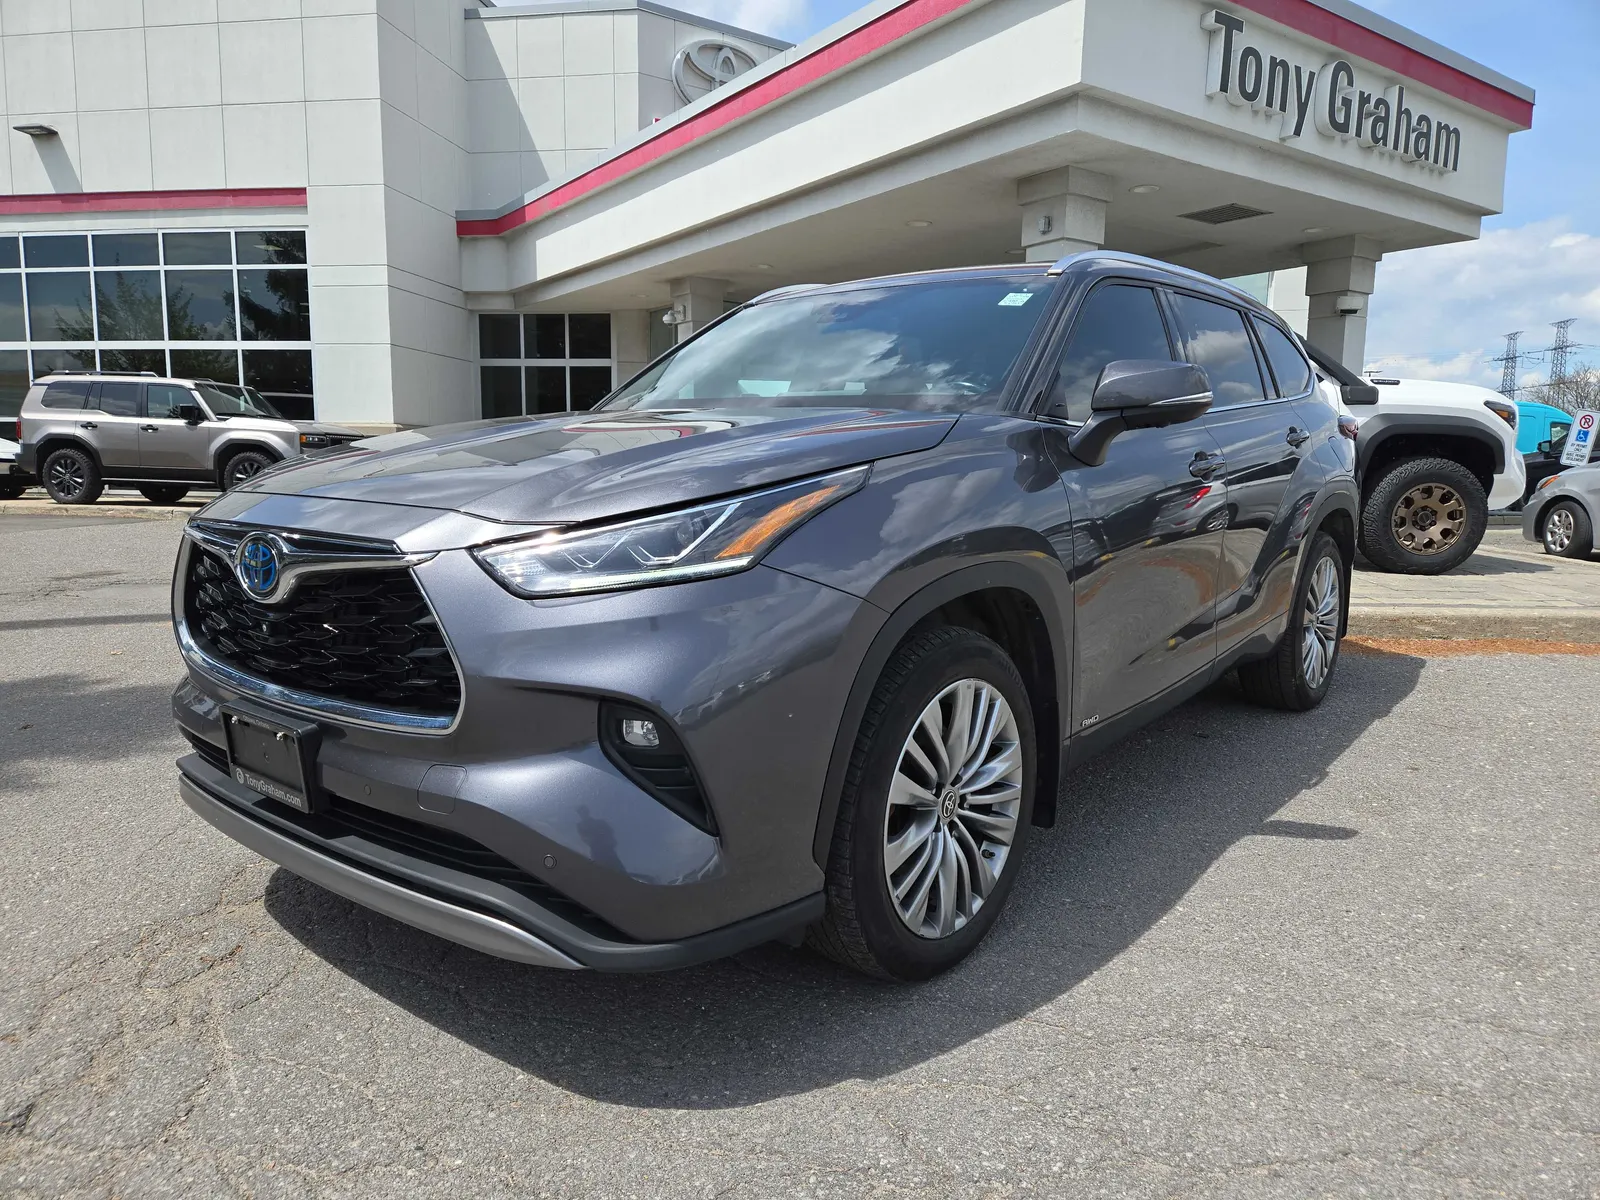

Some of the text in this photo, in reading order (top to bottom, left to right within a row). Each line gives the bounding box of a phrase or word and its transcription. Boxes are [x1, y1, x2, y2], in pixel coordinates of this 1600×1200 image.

[1213, 11, 1462, 172] Tony Graham
[1082, 714, 1098, 727] AWD
[244, 774, 302, 807] TonyGraham.com
